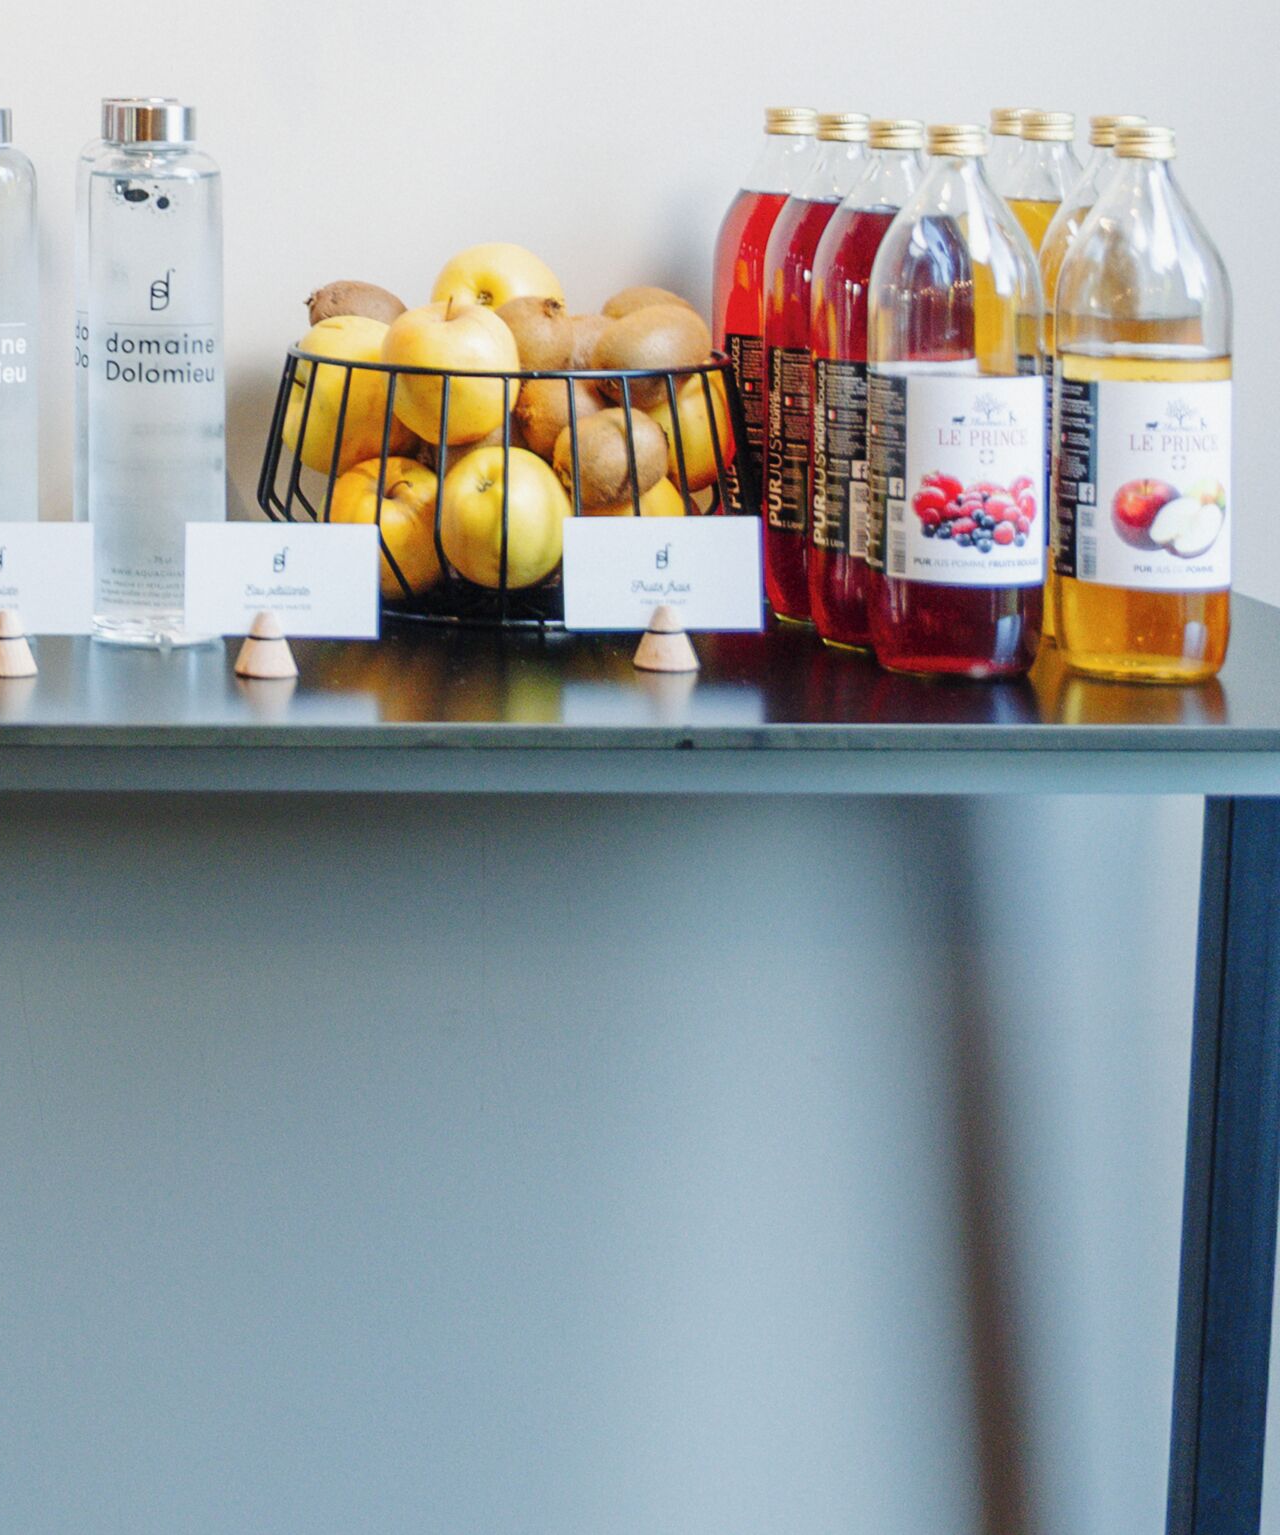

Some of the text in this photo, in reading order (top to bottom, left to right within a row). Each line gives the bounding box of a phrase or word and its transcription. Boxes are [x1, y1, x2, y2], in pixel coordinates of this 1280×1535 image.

[106, 332, 215, 355] domaine
[106, 360, 215, 384] Dolomieu
[938, 428, 1028, 447] LE PRINCE
[1130, 433, 1219, 452] LE PRINCE
[769, 439, 783, 527] PUR JUS
[813, 453, 827, 545] PUR JUS
